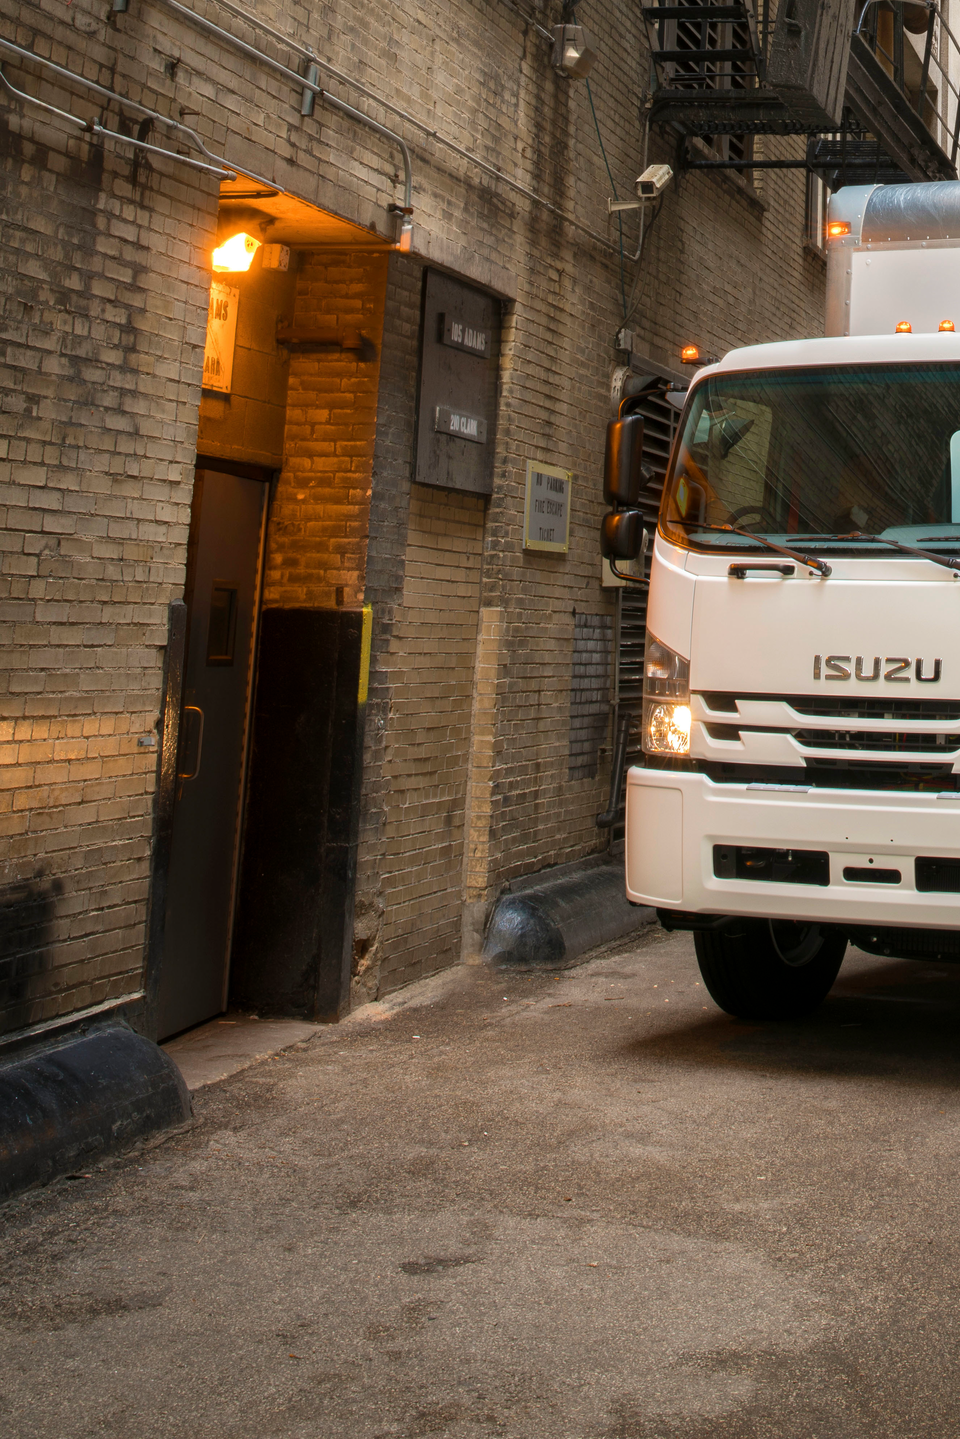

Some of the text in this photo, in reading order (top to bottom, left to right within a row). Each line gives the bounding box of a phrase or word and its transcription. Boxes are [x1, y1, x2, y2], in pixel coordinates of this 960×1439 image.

[209, 297, 229, 322] AMS
[452, 322, 486, 351] 105 ADAMS
[204, 355, 221, 376] ARK
[460, 416, 478, 436] CLARK
[535, 499, 563, 517] FIRE ESCAPE
[539, 526, 555, 542] TICKET
[813, 654, 942, 683] ISUZU
